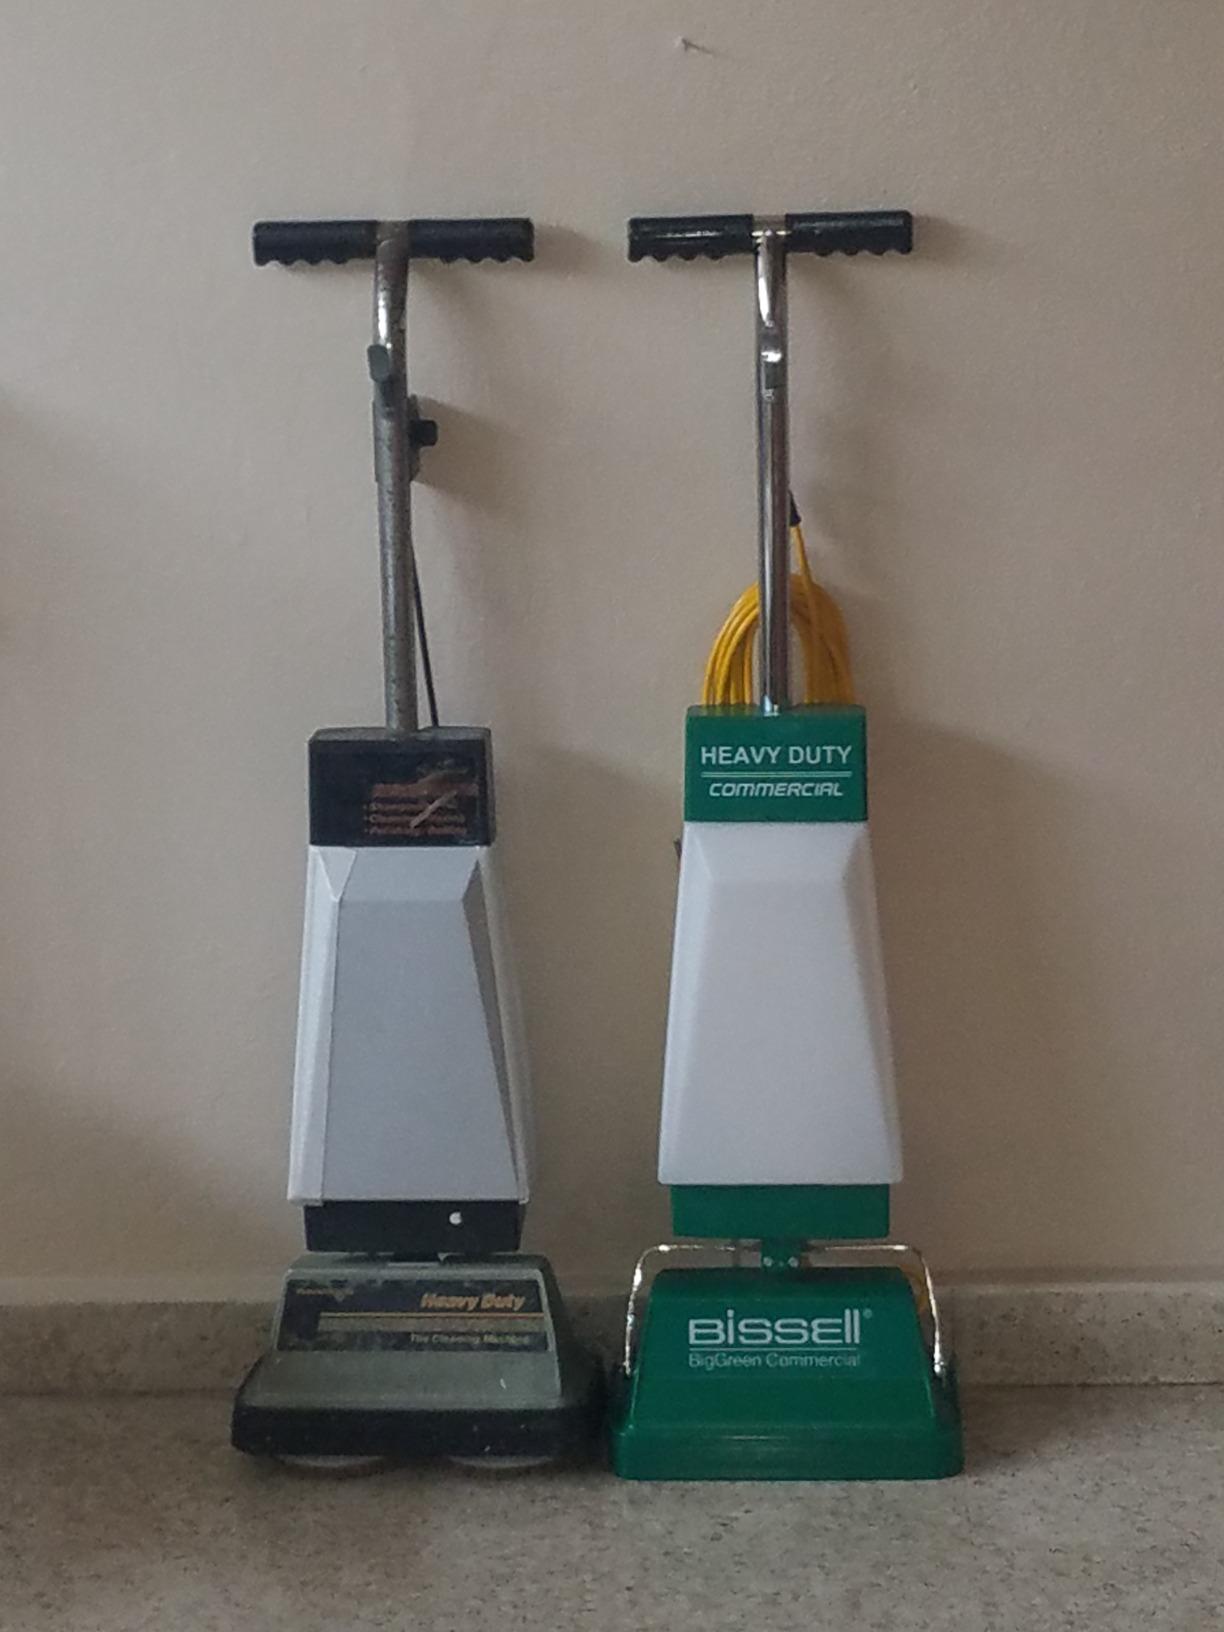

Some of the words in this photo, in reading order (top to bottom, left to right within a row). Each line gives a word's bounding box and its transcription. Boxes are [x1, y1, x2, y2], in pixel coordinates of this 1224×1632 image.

[700, 746, 781, 765] HEAVY
[788, 746, 853, 764] DUTY
[709, 782, 844, 797] COMMERCIAL
[419, 1293, 479, 1311] Heavy
[481, 1293, 527, 1311] Duty
[688, 1352, 763, 1371] BigGreen
[766, 1352, 861, 1368] Commercial
